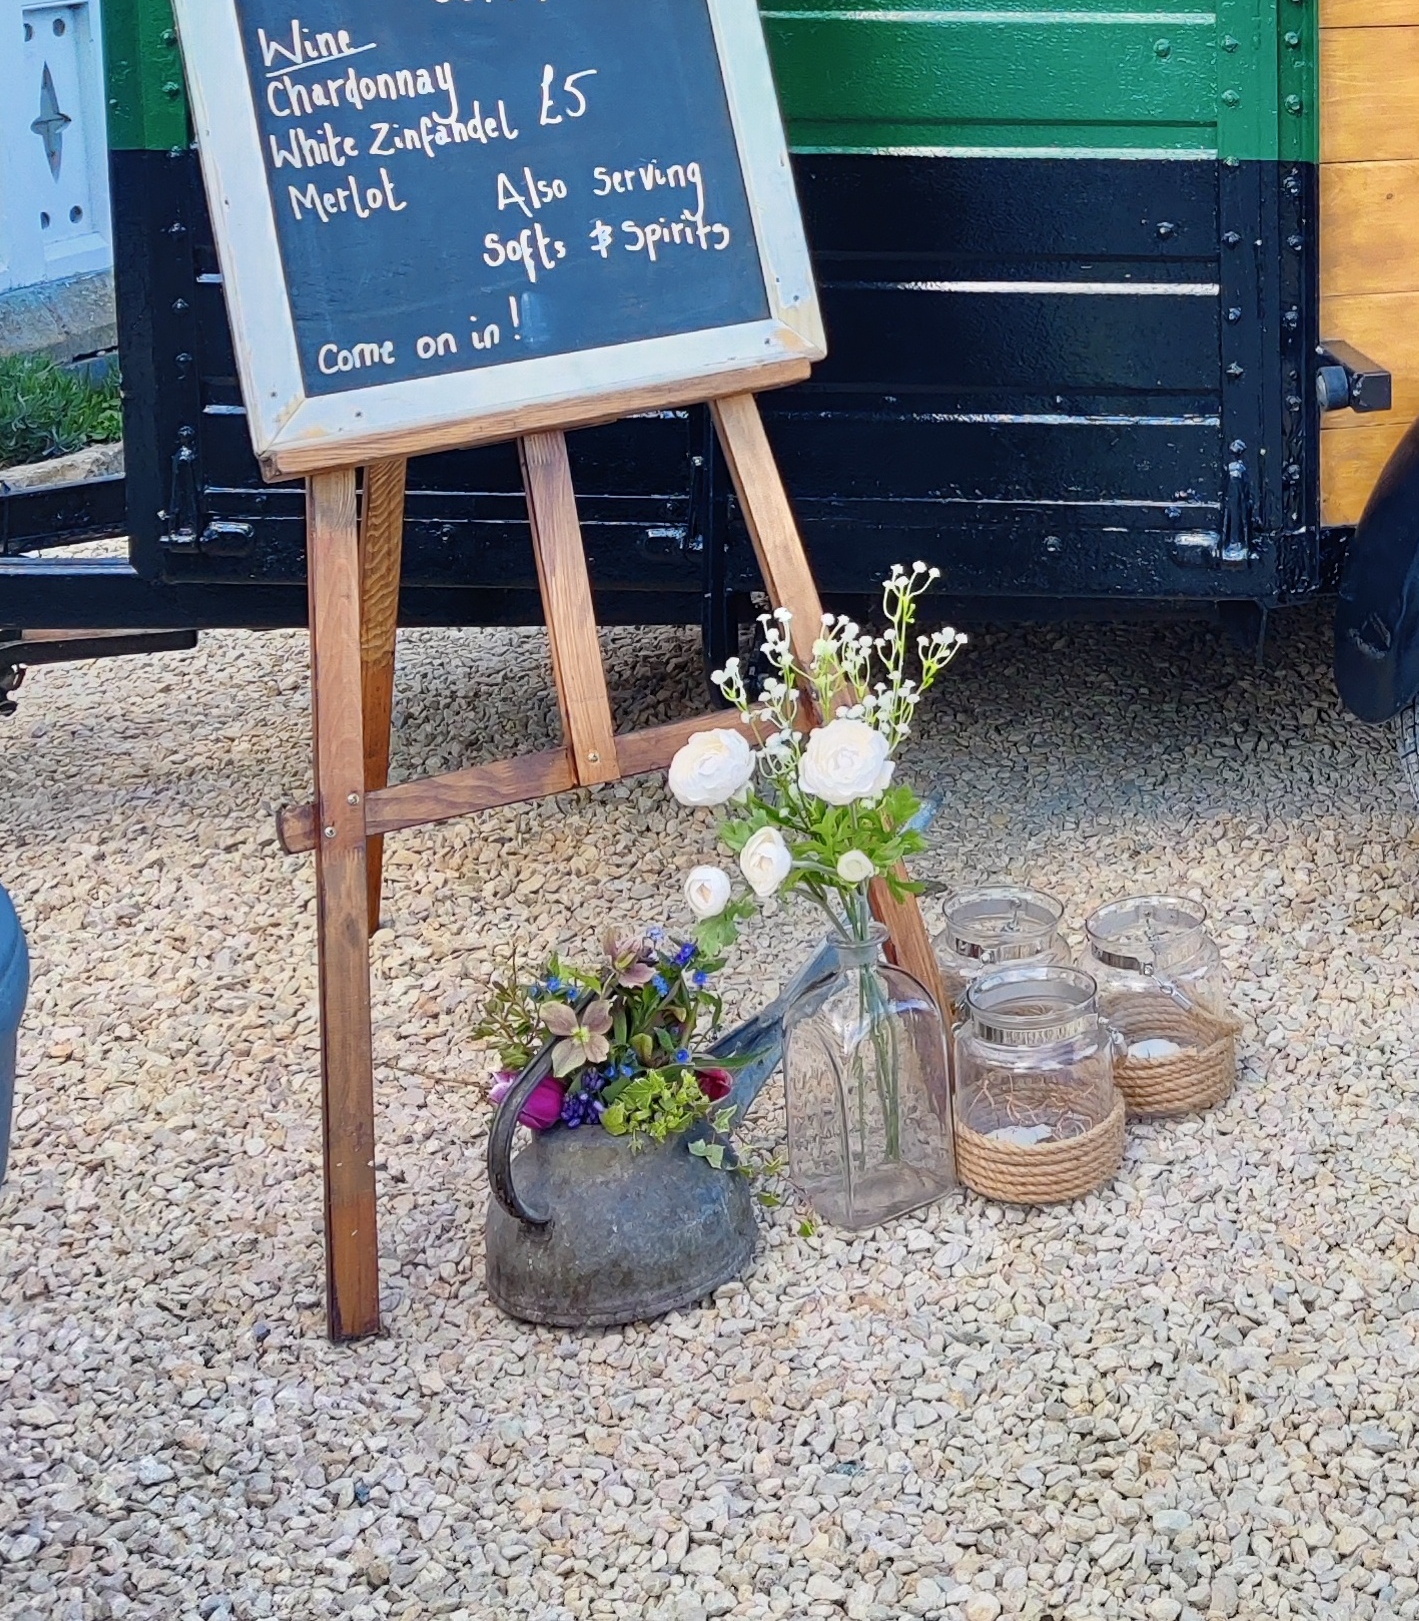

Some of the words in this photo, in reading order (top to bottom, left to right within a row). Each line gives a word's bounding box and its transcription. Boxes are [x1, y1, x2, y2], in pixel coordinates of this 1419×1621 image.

[257, 19, 354, 66] Wine
[267, 62, 458, 124] Chardonnay
[539, 63, 597, 125] £5
[270, 122, 358, 169] White
[369, 100, 519, 158] Zinfandel
[288, 167, 407, 223] Merlot
[498, 167, 567, 218] Also
[317, 339, 396, 375] Come
[416, 332, 458, 360] on
